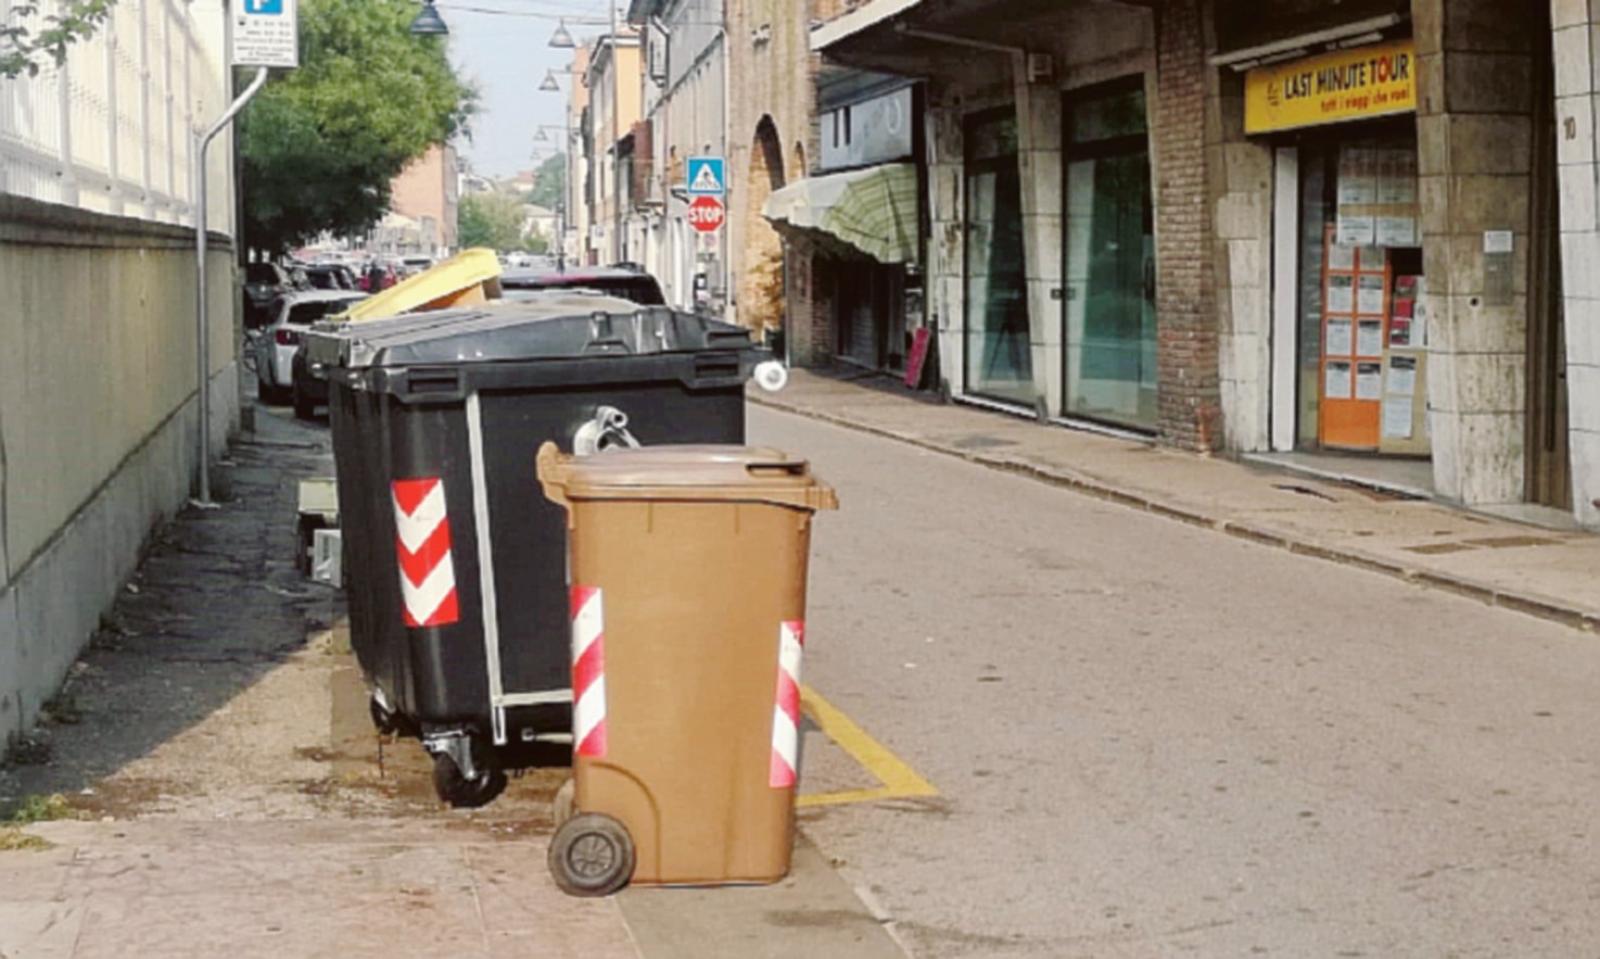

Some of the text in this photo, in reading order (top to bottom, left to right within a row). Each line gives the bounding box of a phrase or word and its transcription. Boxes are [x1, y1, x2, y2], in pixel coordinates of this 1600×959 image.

[1284, 53, 1409, 99] LAST MINUTE TOUR
[689, 206, 723, 223] STOP
